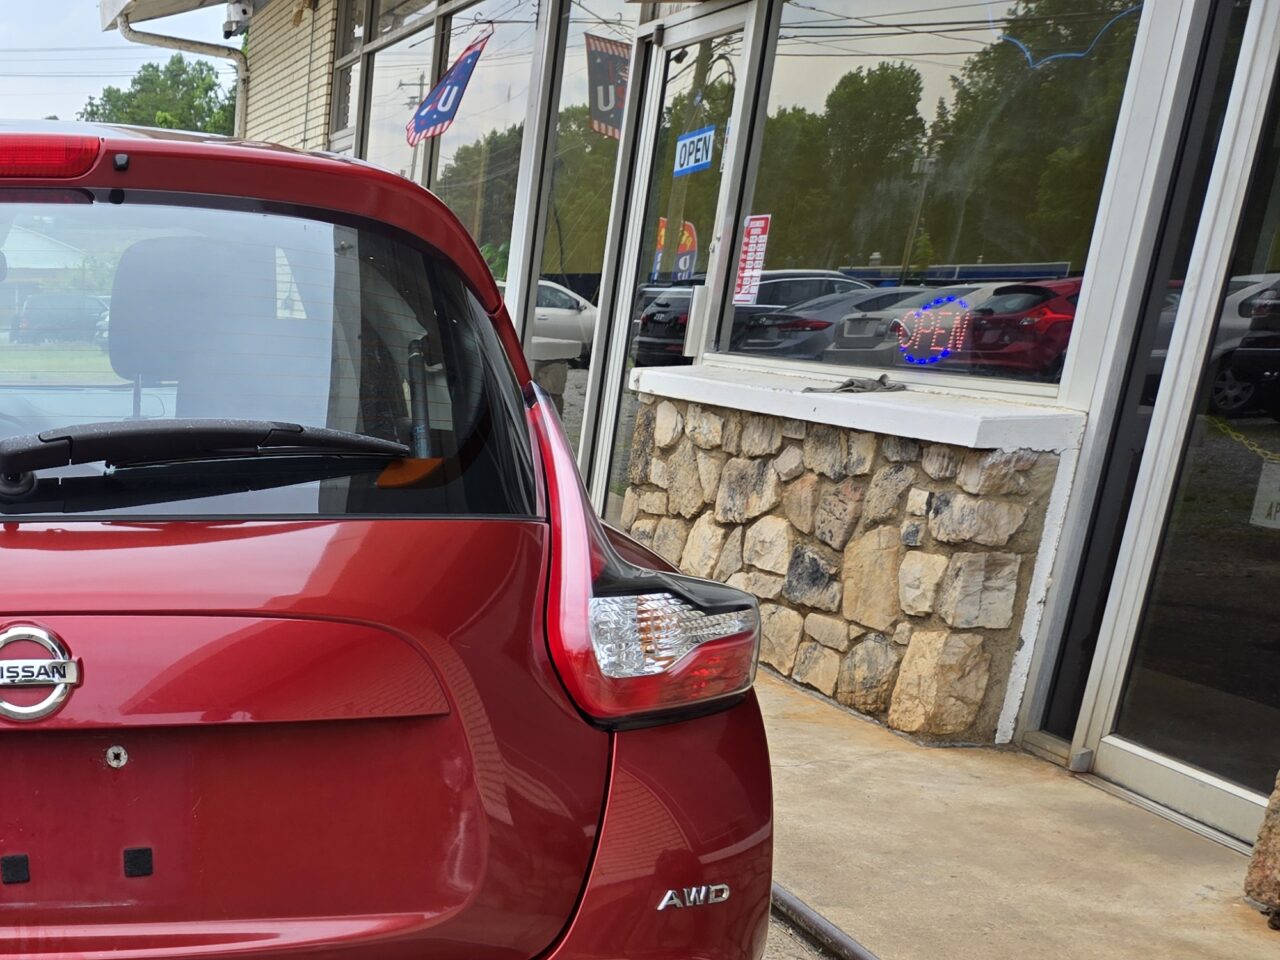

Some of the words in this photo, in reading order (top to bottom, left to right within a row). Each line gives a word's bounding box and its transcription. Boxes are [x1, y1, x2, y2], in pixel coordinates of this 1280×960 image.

[679, 134, 711, 168] OPEN
[899, 311, 970, 352] OPEN
[656, 883, 730, 911] AWD
